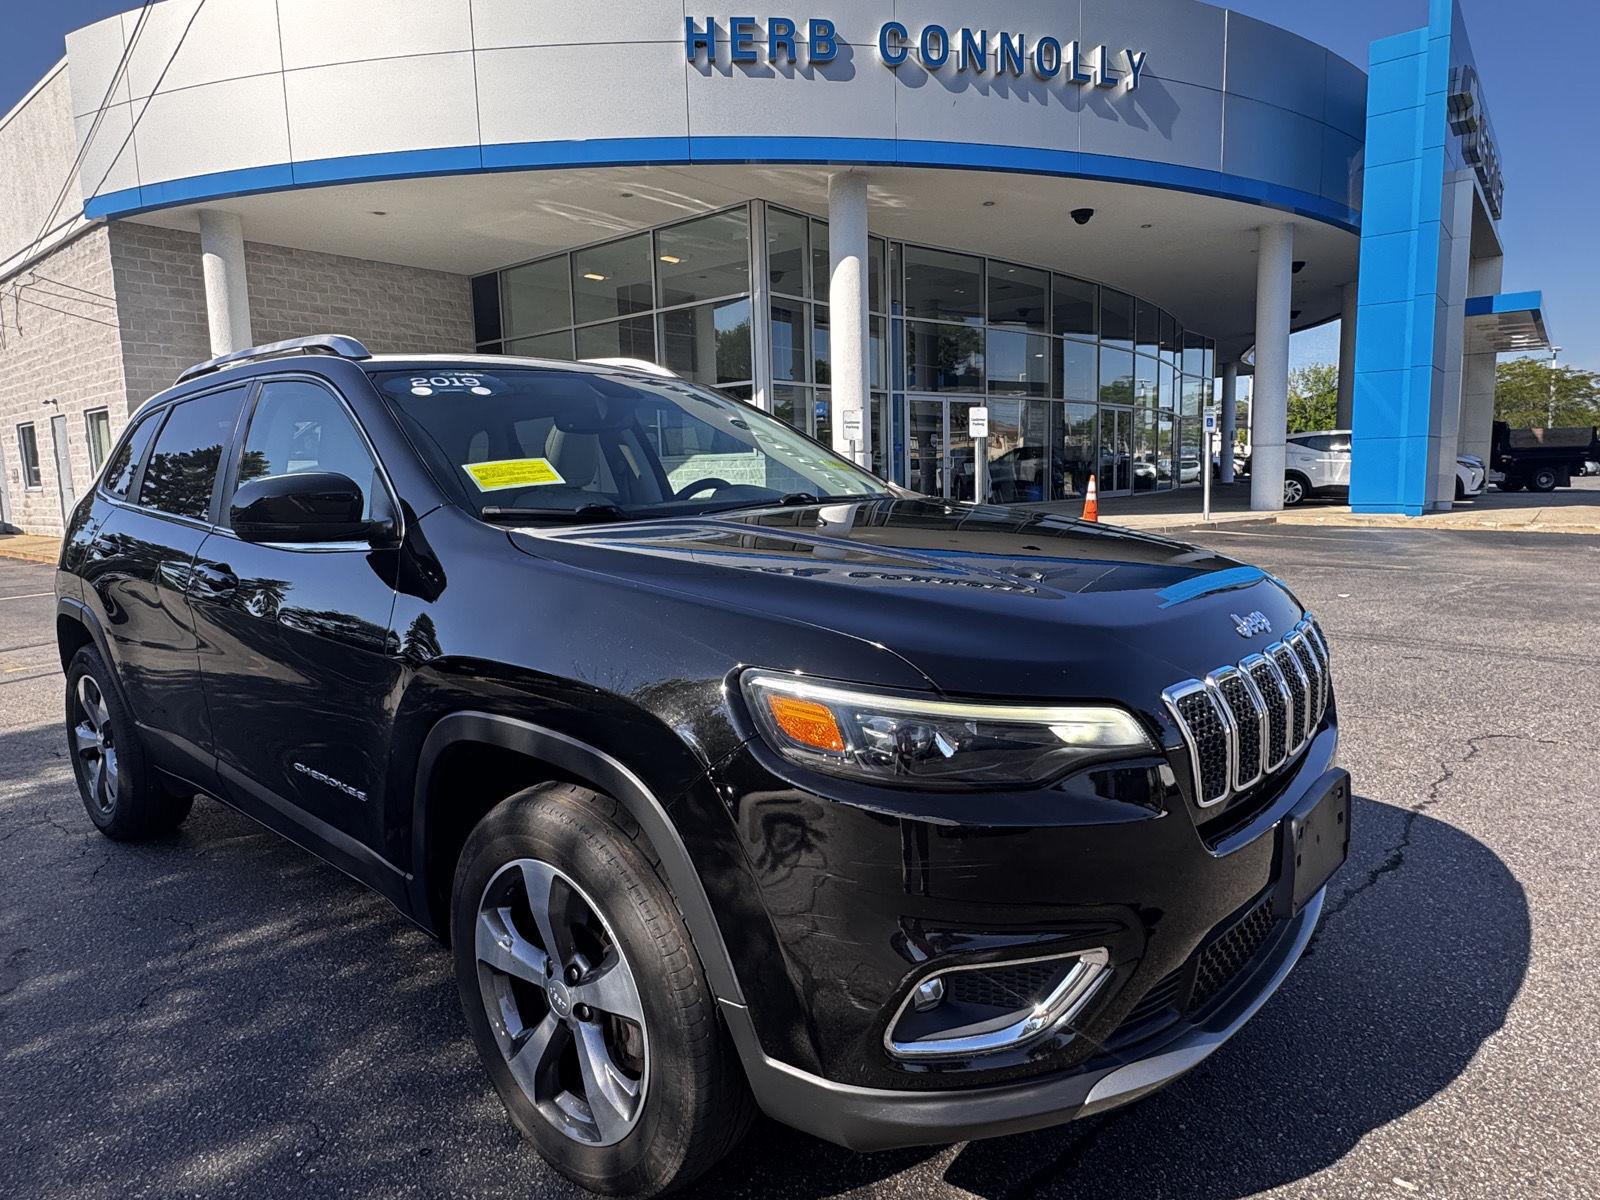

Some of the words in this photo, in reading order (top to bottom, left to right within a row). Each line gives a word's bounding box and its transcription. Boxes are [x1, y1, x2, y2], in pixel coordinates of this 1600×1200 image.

[684, 16, 840, 63] HERB
[878, 21, 1147, 91] CONNOLLY
[410, 377, 481, 387] 2019
[1230, 610, 1272, 638] Jeep
